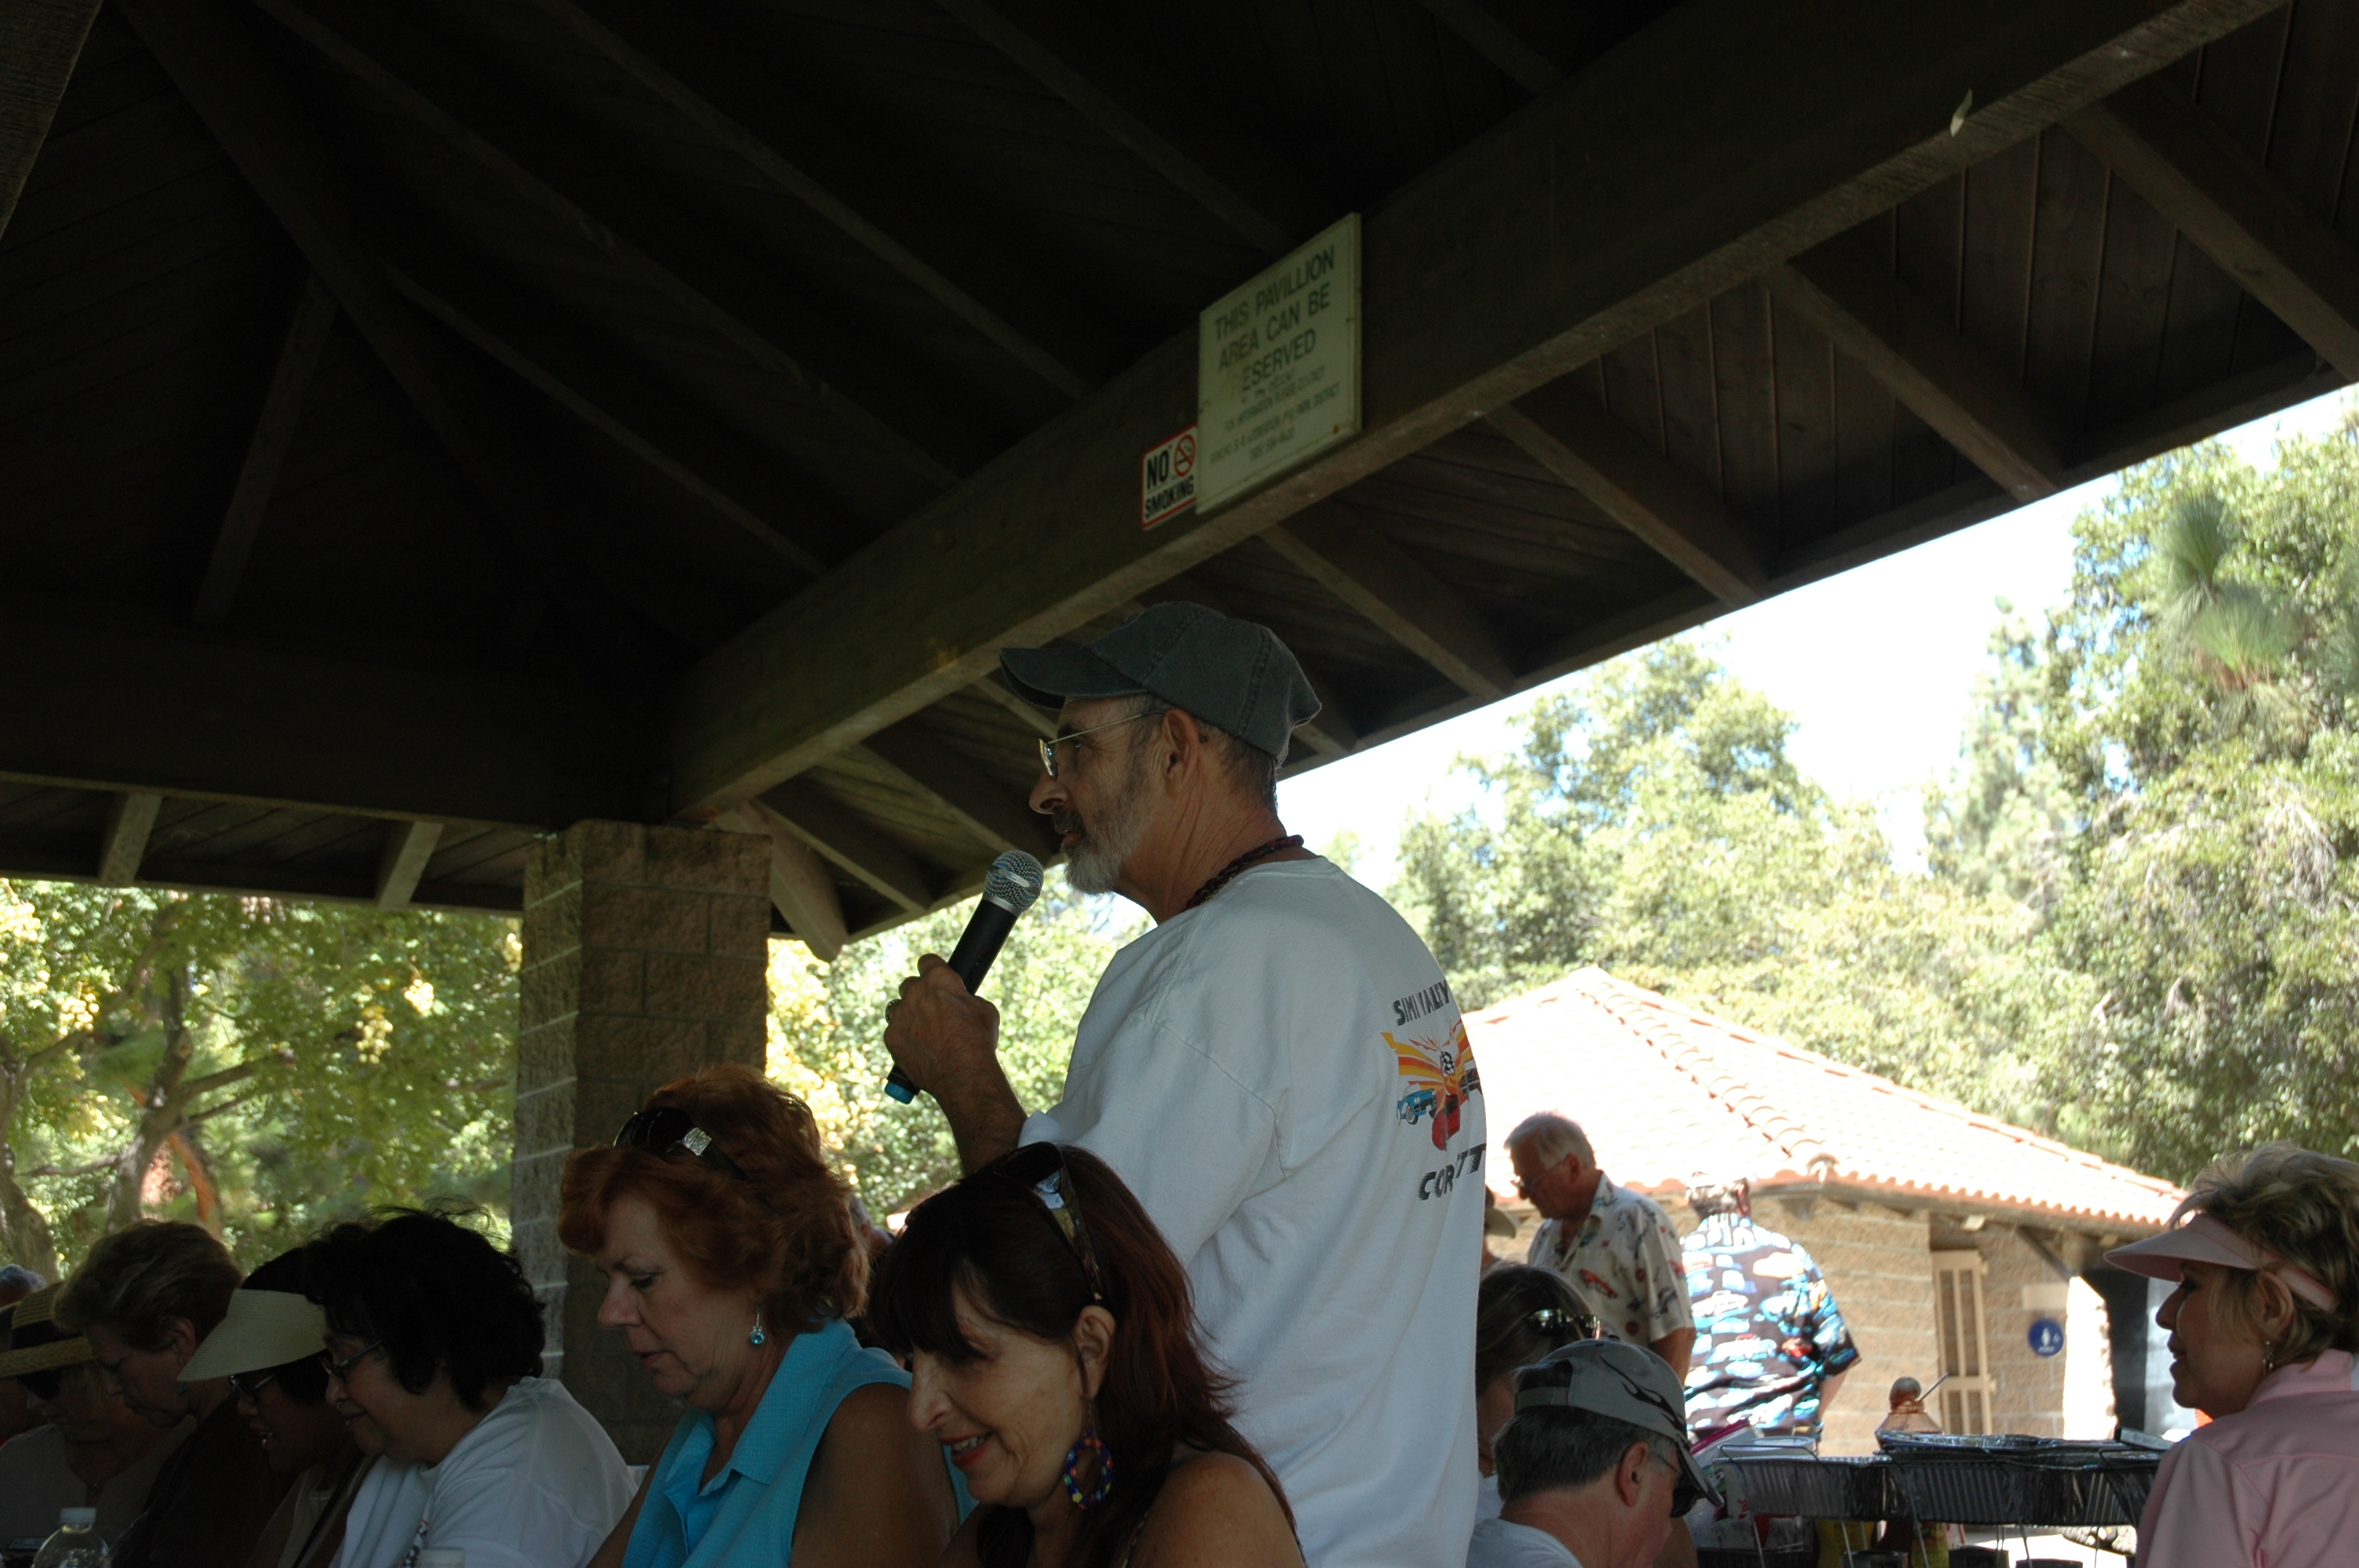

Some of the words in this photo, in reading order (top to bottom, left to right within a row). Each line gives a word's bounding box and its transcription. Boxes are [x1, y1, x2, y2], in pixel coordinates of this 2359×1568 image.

[1216, 300, 1249, 341] THIS
[1256, 244, 1335, 316] PAVILLION
[1219, 326, 1259, 373] AREA
[1267, 299, 1300, 342] CAN
[1309, 281, 1331, 317] BE
[1145, 474, 1194, 518] SMOKING
[1147, 449, 1169, 490] NO
